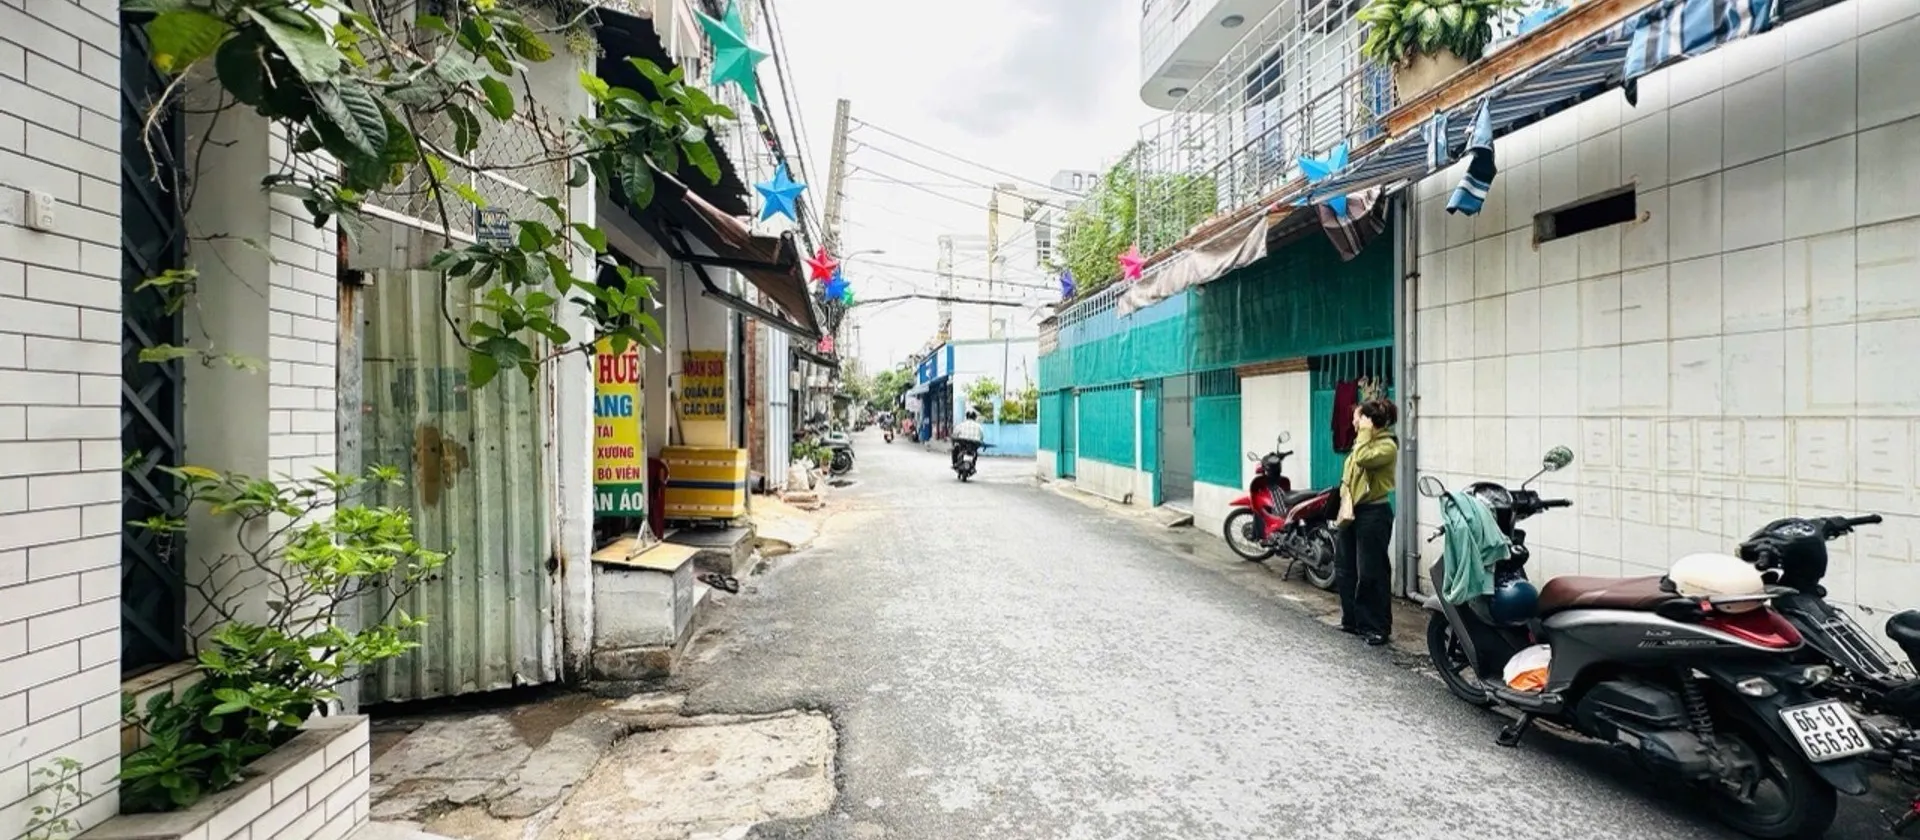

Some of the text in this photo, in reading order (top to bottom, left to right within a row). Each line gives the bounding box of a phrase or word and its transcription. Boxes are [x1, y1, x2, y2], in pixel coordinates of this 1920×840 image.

[619, 488, 643, 511] ÁO
[1792, 704, 1845, 733] 66-G1
[1803, 726, 1864, 757] 656.58
